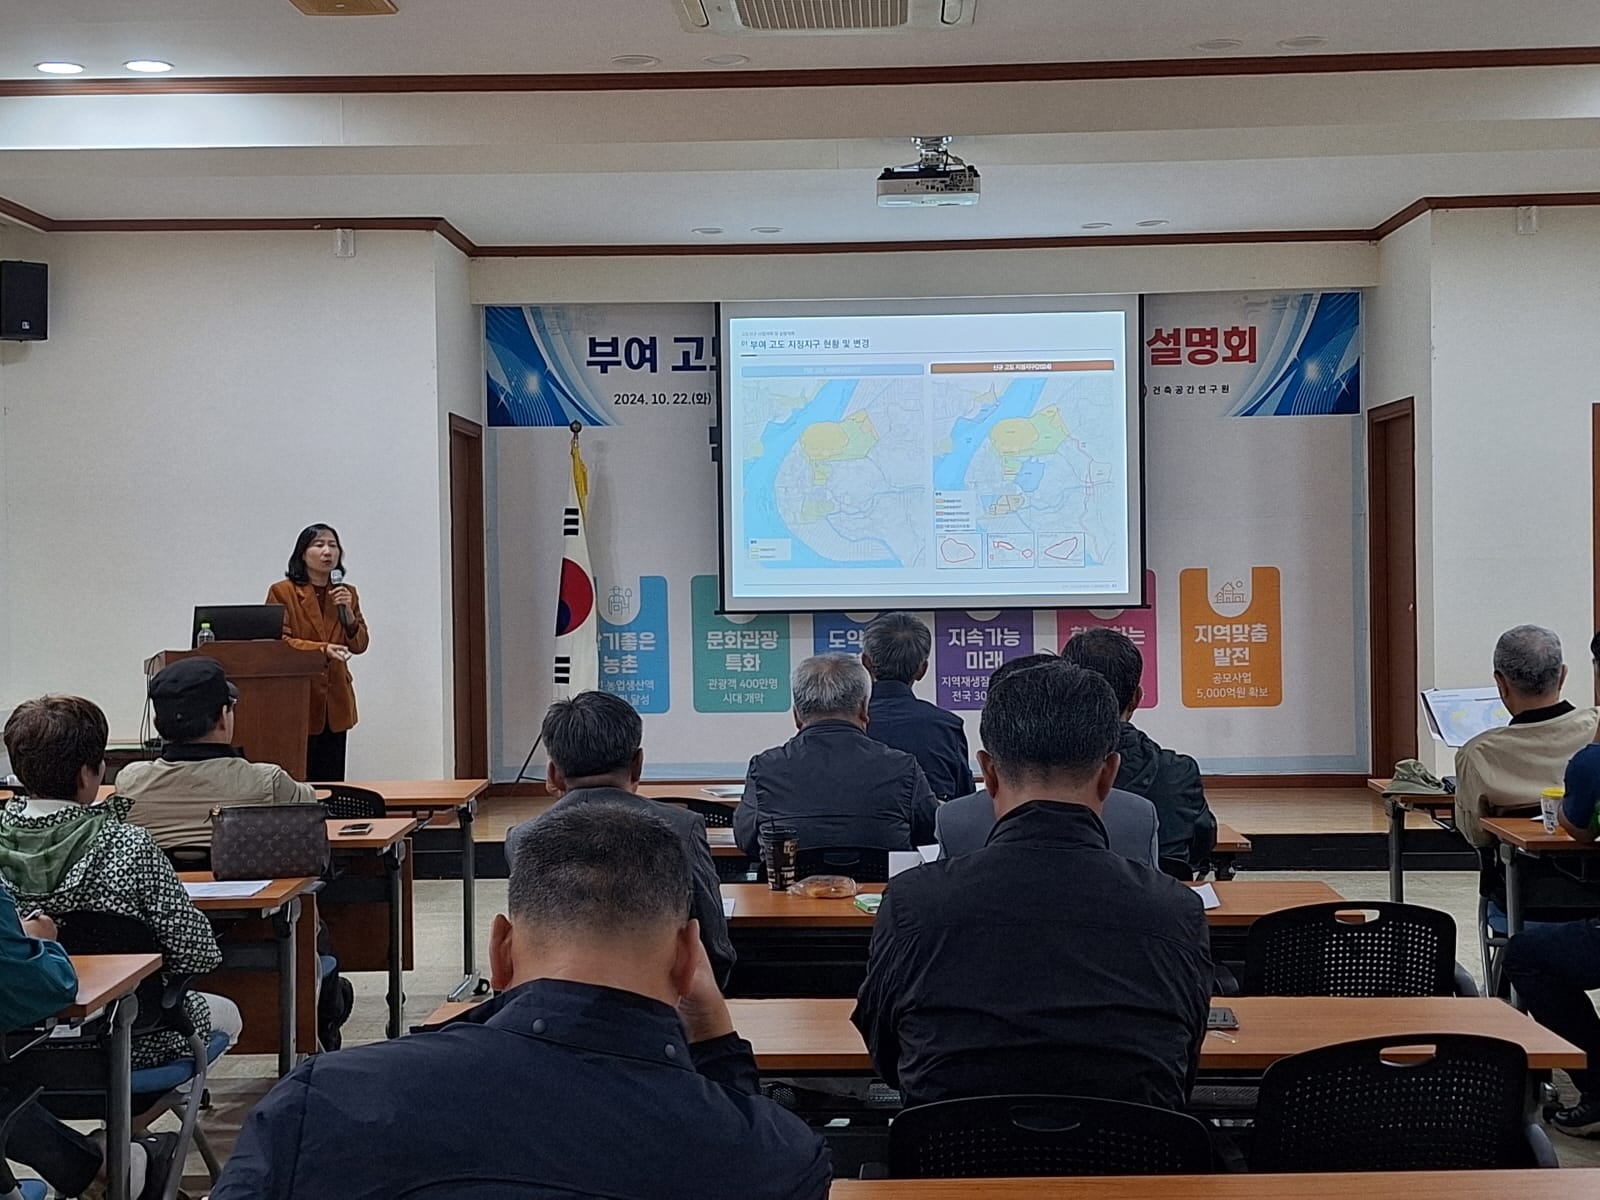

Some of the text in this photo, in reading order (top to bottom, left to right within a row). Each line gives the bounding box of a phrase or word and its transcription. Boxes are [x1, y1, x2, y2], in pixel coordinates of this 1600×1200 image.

[750, 340, 767, 350] 부여
[768, 340, 785, 349] 고도
[1146, 326, 1257, 366] 설명회
[586, 336, 716, 374] 부여 고
[614, 393, 649, 405] 2024.
[651, 393, 670, 405] 10.
[597, 632, 656, 651] 기좋은
[706, 630, 779, 650] 문화관광
[828, 630, 865, 649] 도약
[948, 628, 1021, 647] 지속가능
[1194, 623, 1269, 643] 지역맞춤
[603, 655, 638, 674] 농촌
[725, 653, 761, 672] 특화
[966, 651, 1003, 670] 미래
[1213, 647, 1250, 667] 발전
[708, 677, 778, 690] 관광객 400만명
[941, 676, 990, 688] 지역재생잠
[1212, 672, 1252, 685] 공모사업
[722, 692, 764, 704] 시대 개막
[951, 690, 989, 702] 전국 30
[1196, 687, 1246, 699] 5,000억원
